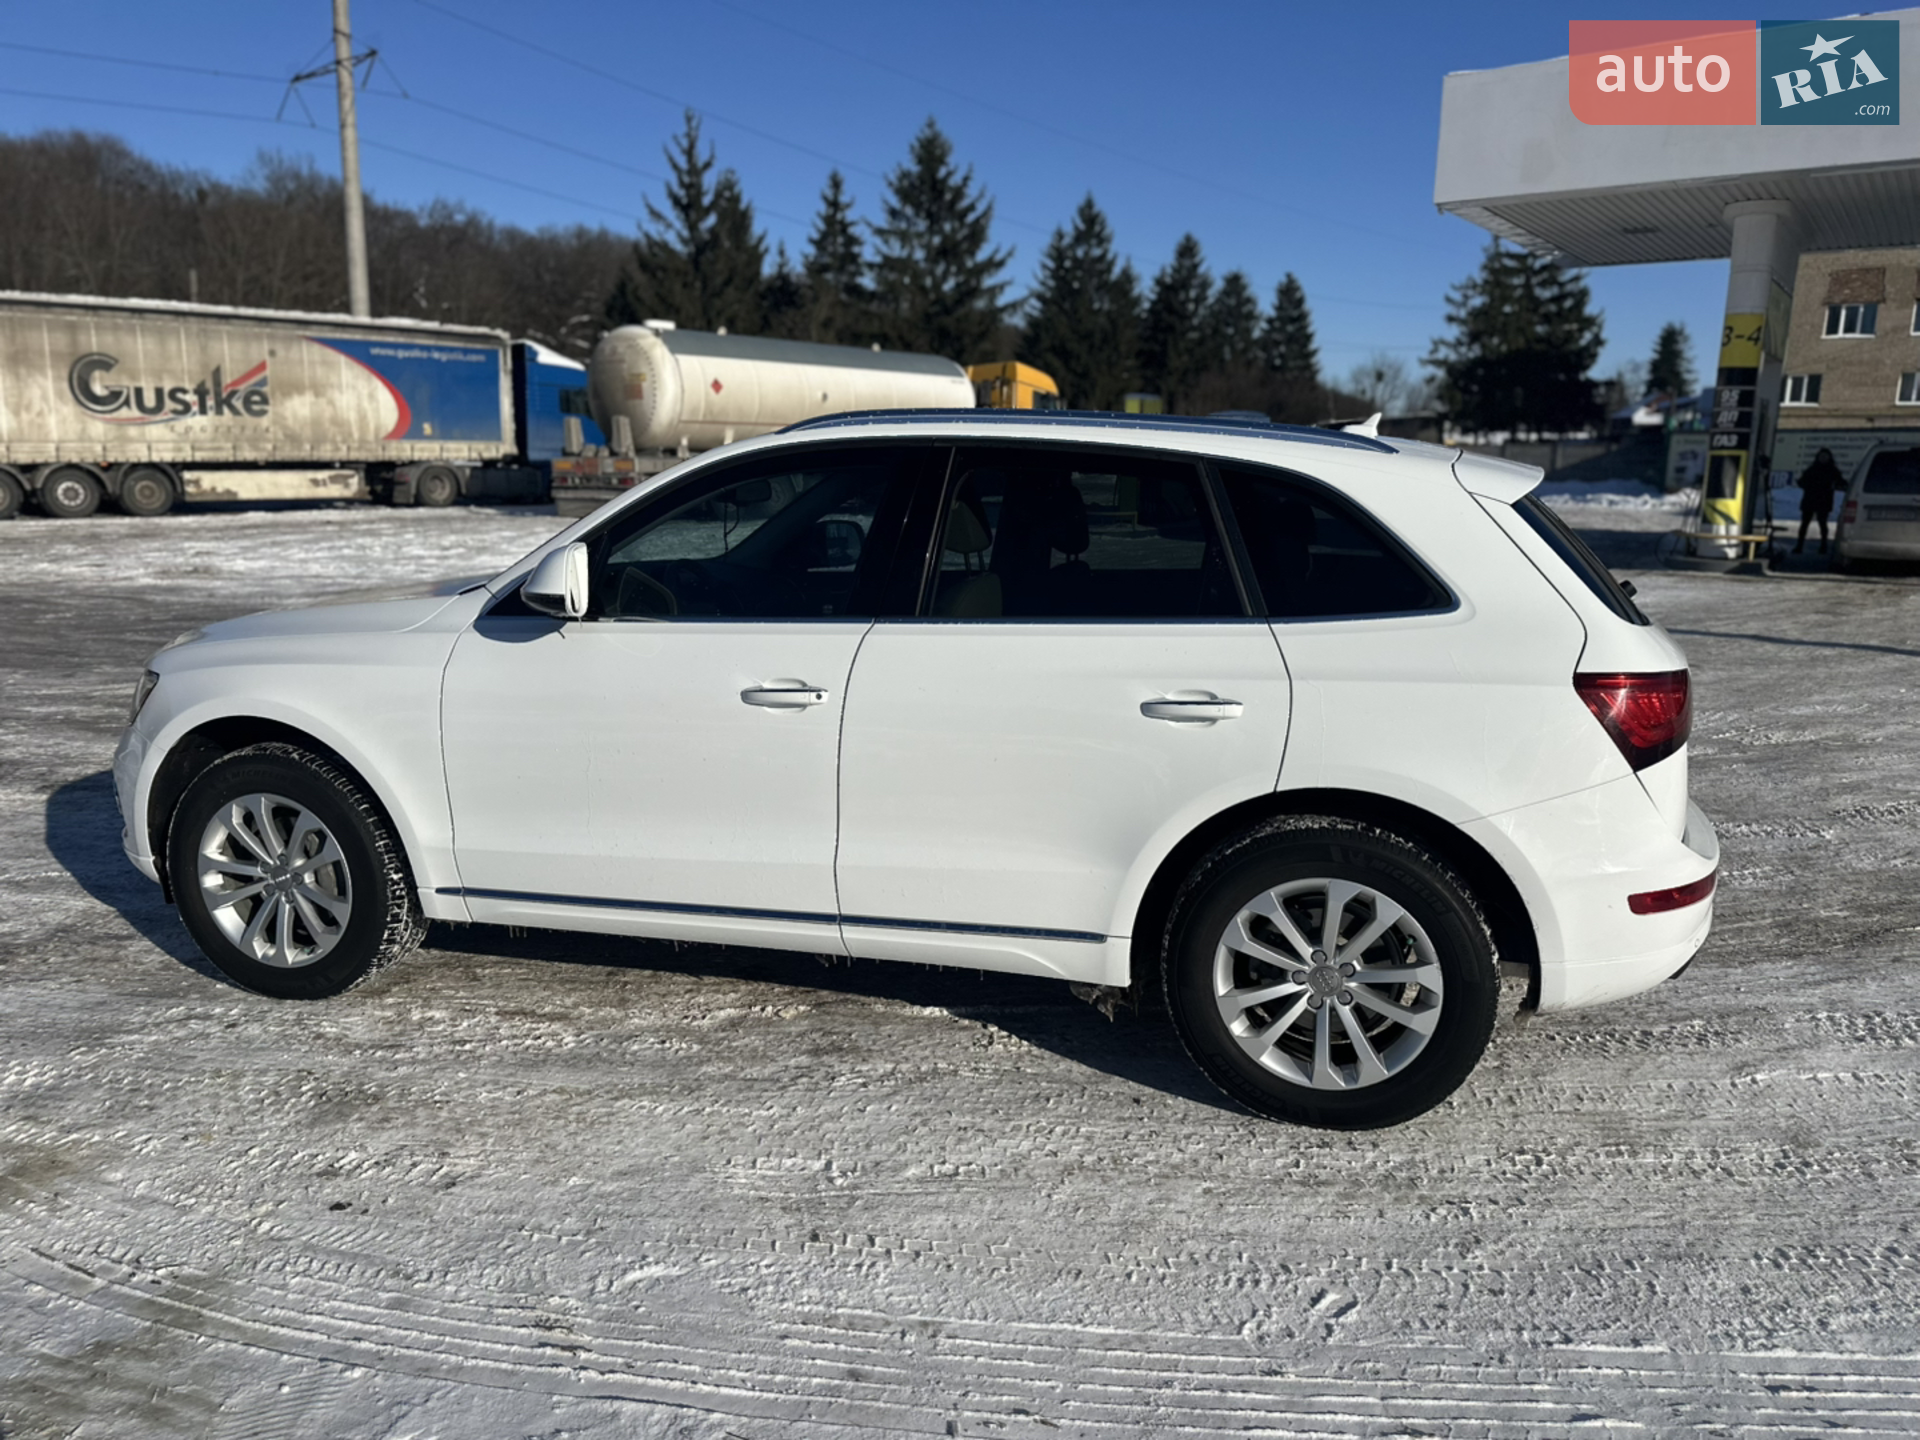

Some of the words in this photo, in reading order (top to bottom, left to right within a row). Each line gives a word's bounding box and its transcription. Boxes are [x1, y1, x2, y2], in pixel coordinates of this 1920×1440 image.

[1720, 325, 1762, 347] 3-4
[68, 351, 271, 417] Gustke
[1721, 389, 1741, 403] 95
[1712, 433, 1739, 448] ГАЗ
[1368, 857, 1448, 916] MICHELIN
[1211, 1054, 1285, 1110] MICHELIN
